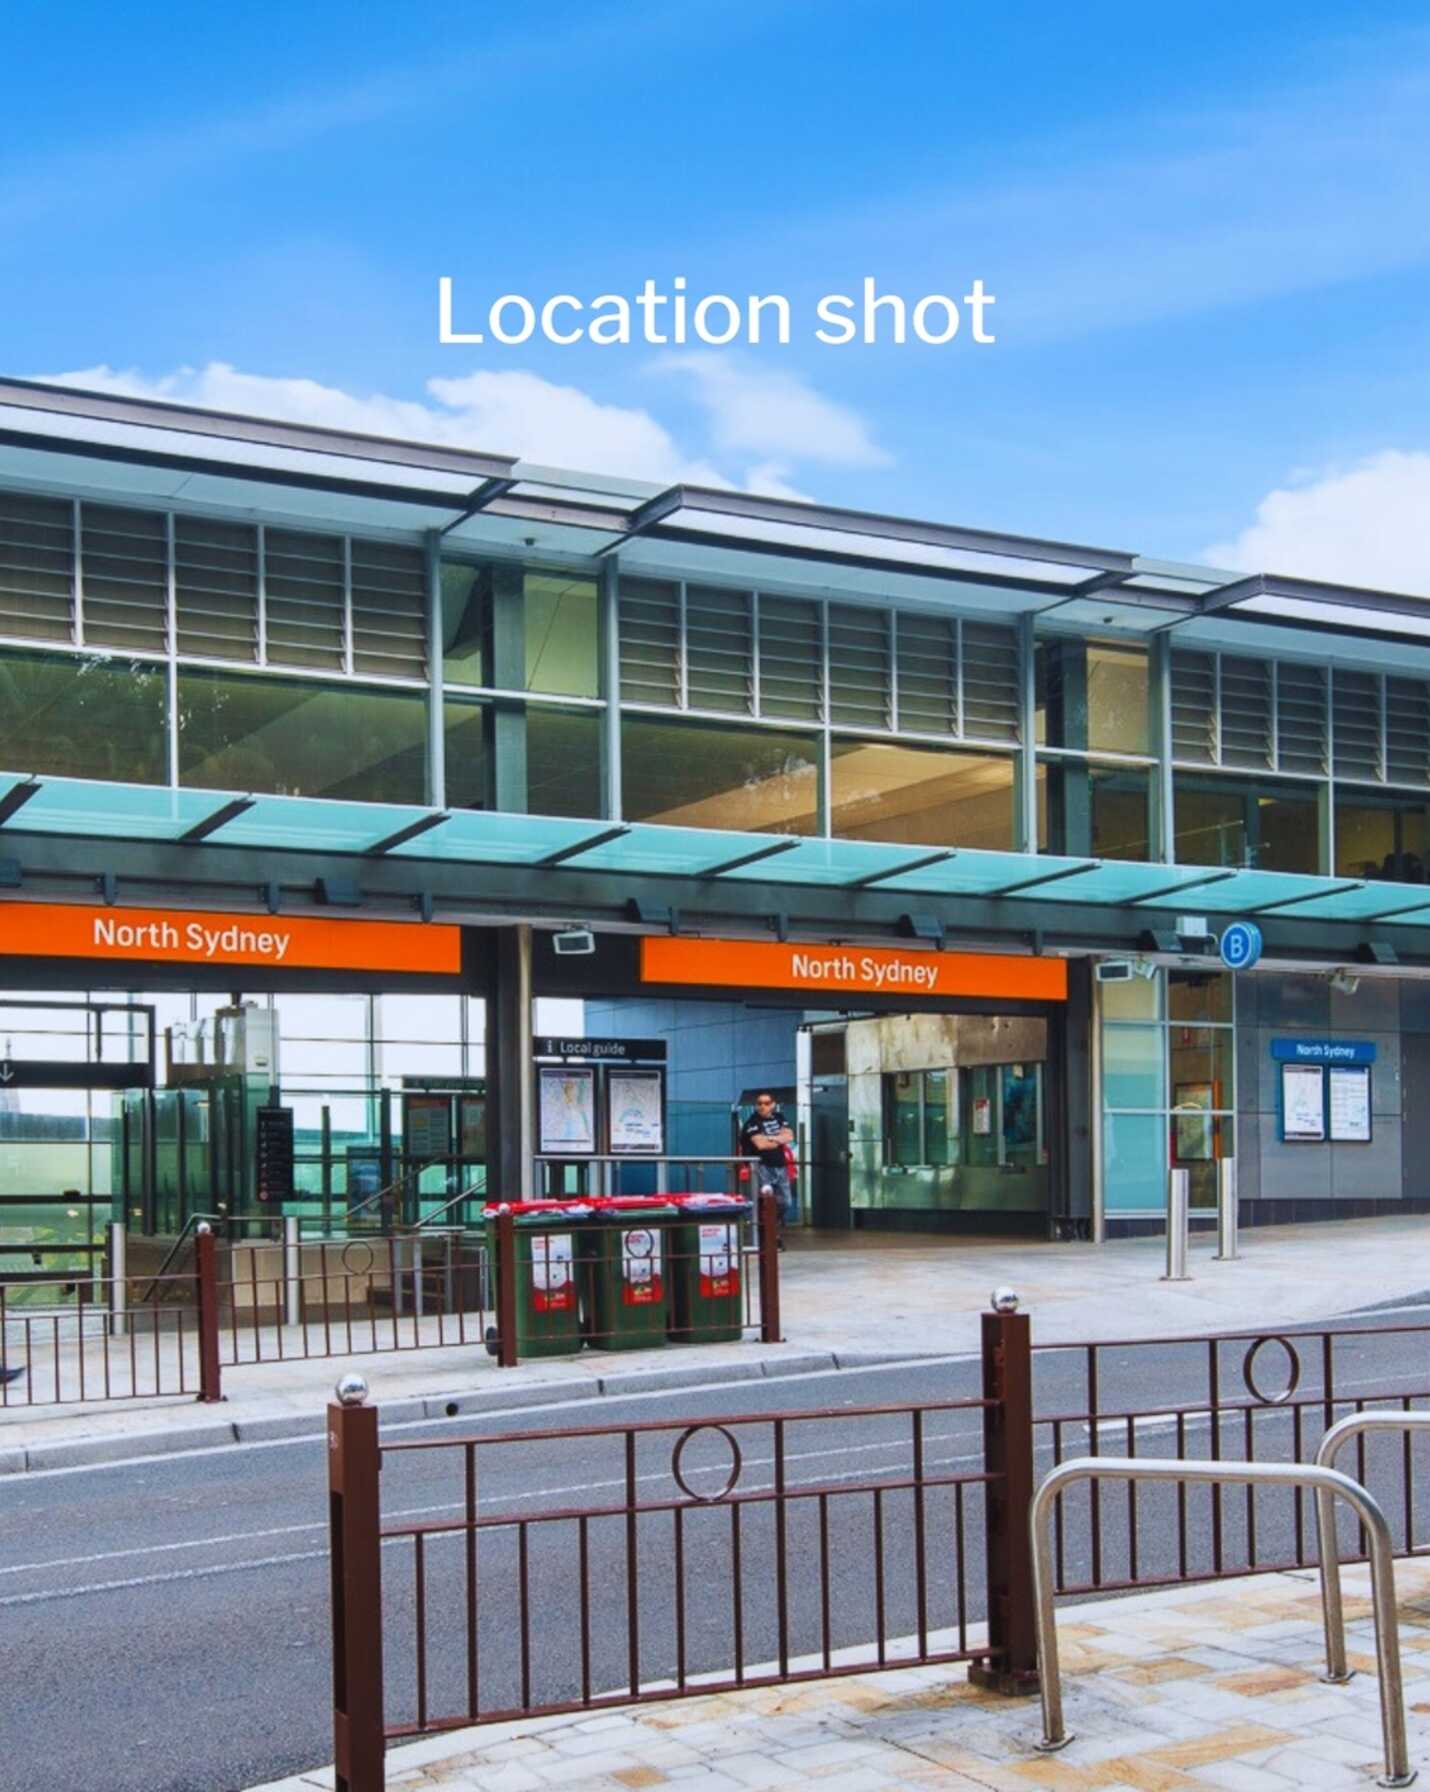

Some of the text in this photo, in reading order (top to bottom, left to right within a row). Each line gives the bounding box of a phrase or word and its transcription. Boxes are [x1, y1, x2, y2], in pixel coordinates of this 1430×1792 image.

[93, 918, 290, 959] North Sydney
[1231, 935, 1243, 958] B
[791, 953, 938, 989] North Sydney
[560, 1041, 591, 1055] Local
[592, 1042, 626, 1057] guide
[1296, 1044, 1355, 1059] North Sydney
